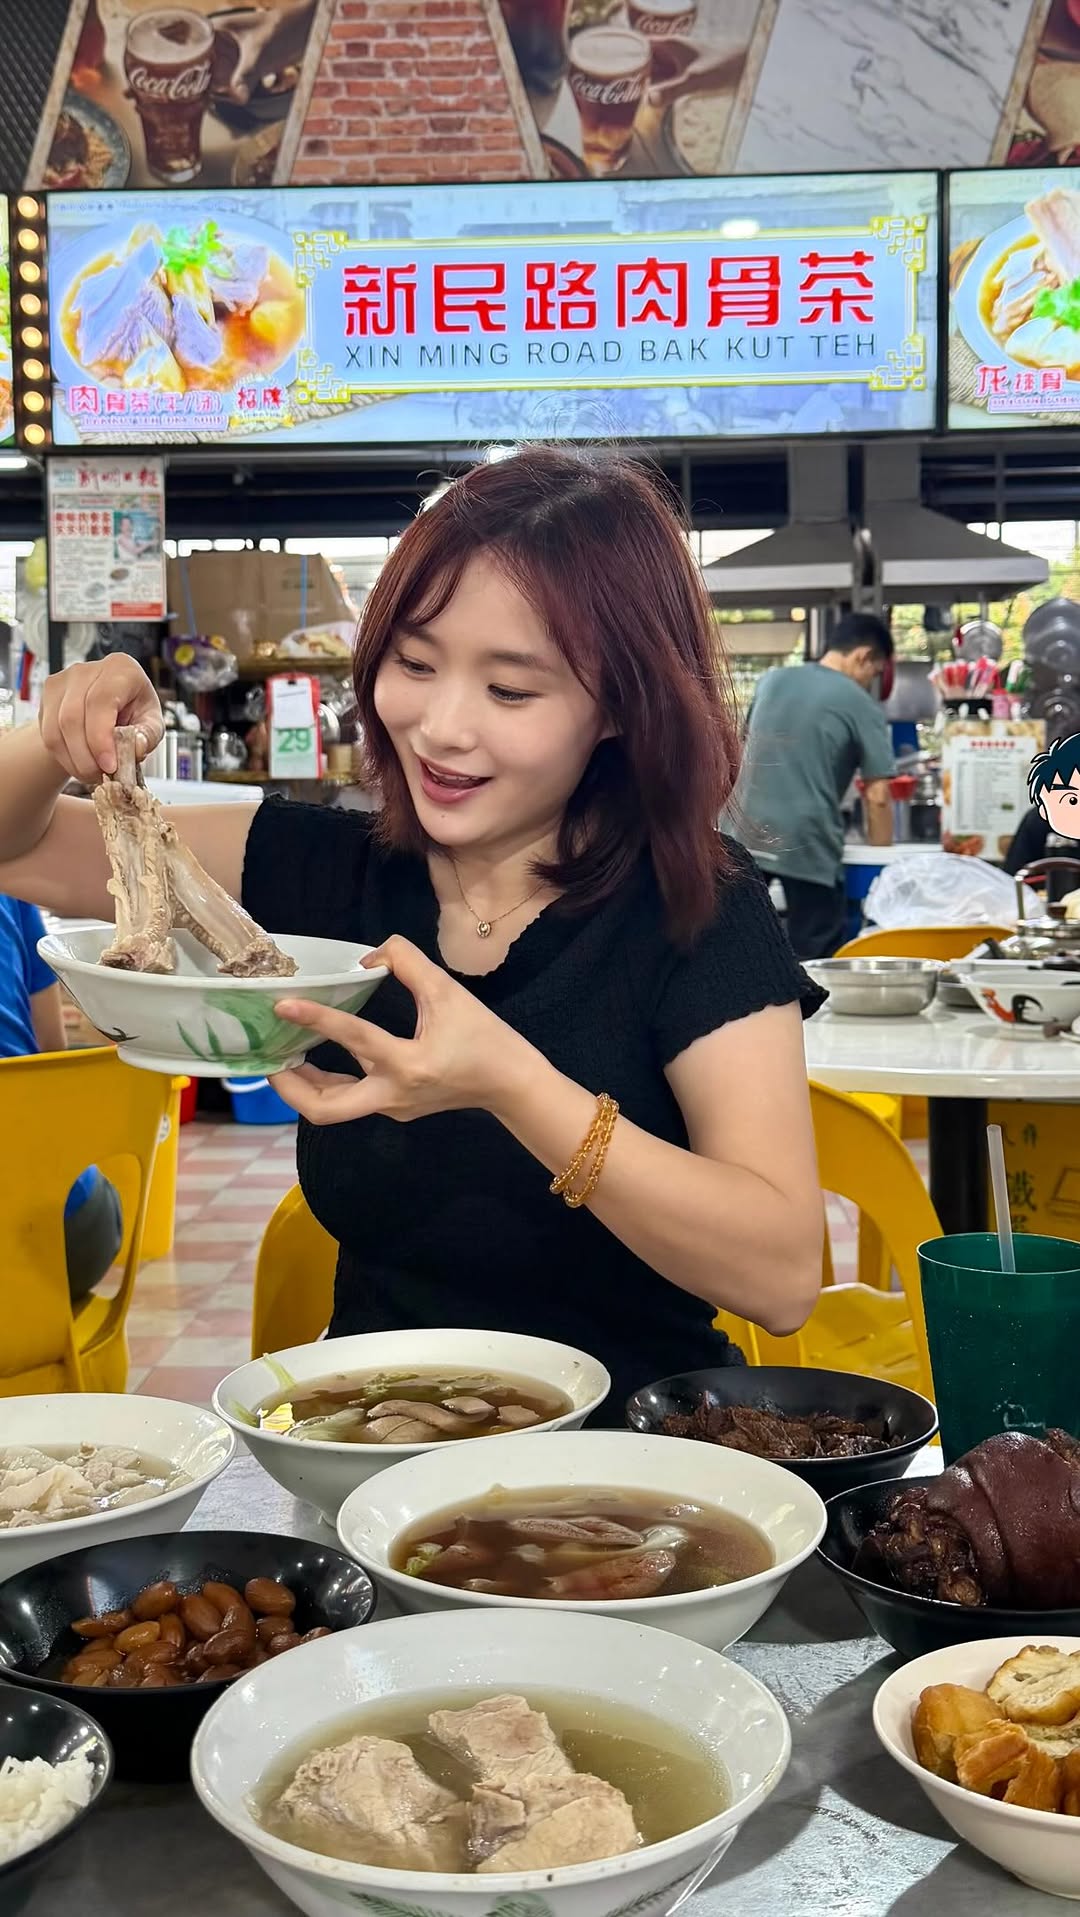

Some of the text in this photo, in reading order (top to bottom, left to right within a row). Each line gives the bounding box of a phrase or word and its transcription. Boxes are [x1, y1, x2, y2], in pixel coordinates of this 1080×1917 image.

[344, 251, 874, 335] 新民路肉骨茶
[345, 333, 875, 368] XIN MING ROAD BAK KUT TEH
[277, 729, 312, 752] 29
